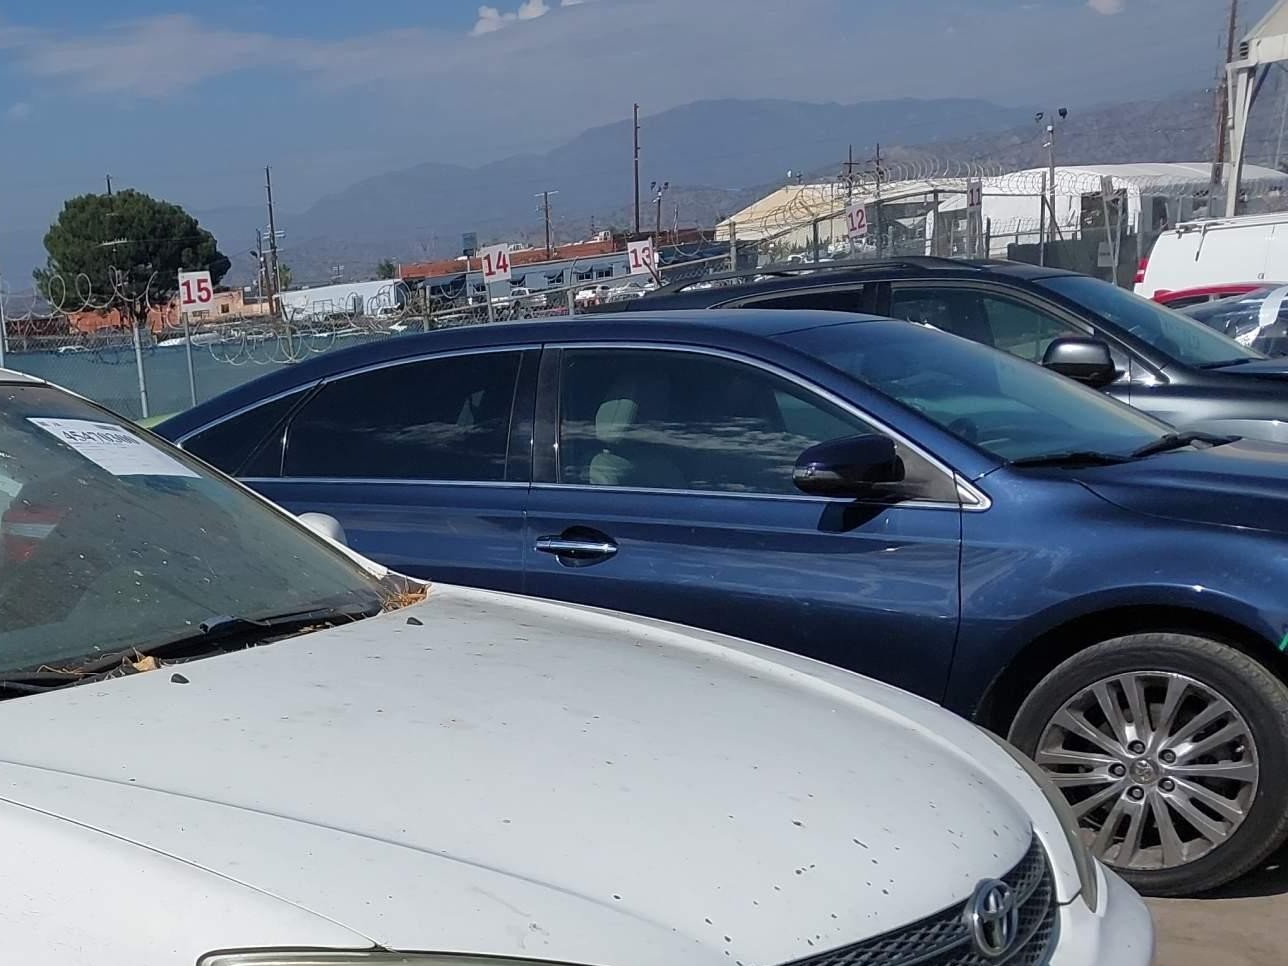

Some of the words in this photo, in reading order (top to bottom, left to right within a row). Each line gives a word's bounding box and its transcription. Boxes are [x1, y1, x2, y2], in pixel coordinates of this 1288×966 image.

[969, 187, 982, 207] 11
[847, 209, 865, 231] 12
[483, 250, 508, 276] 14
[630, 246, 652, 268] 13
[181, 278, 212, 304] 15
